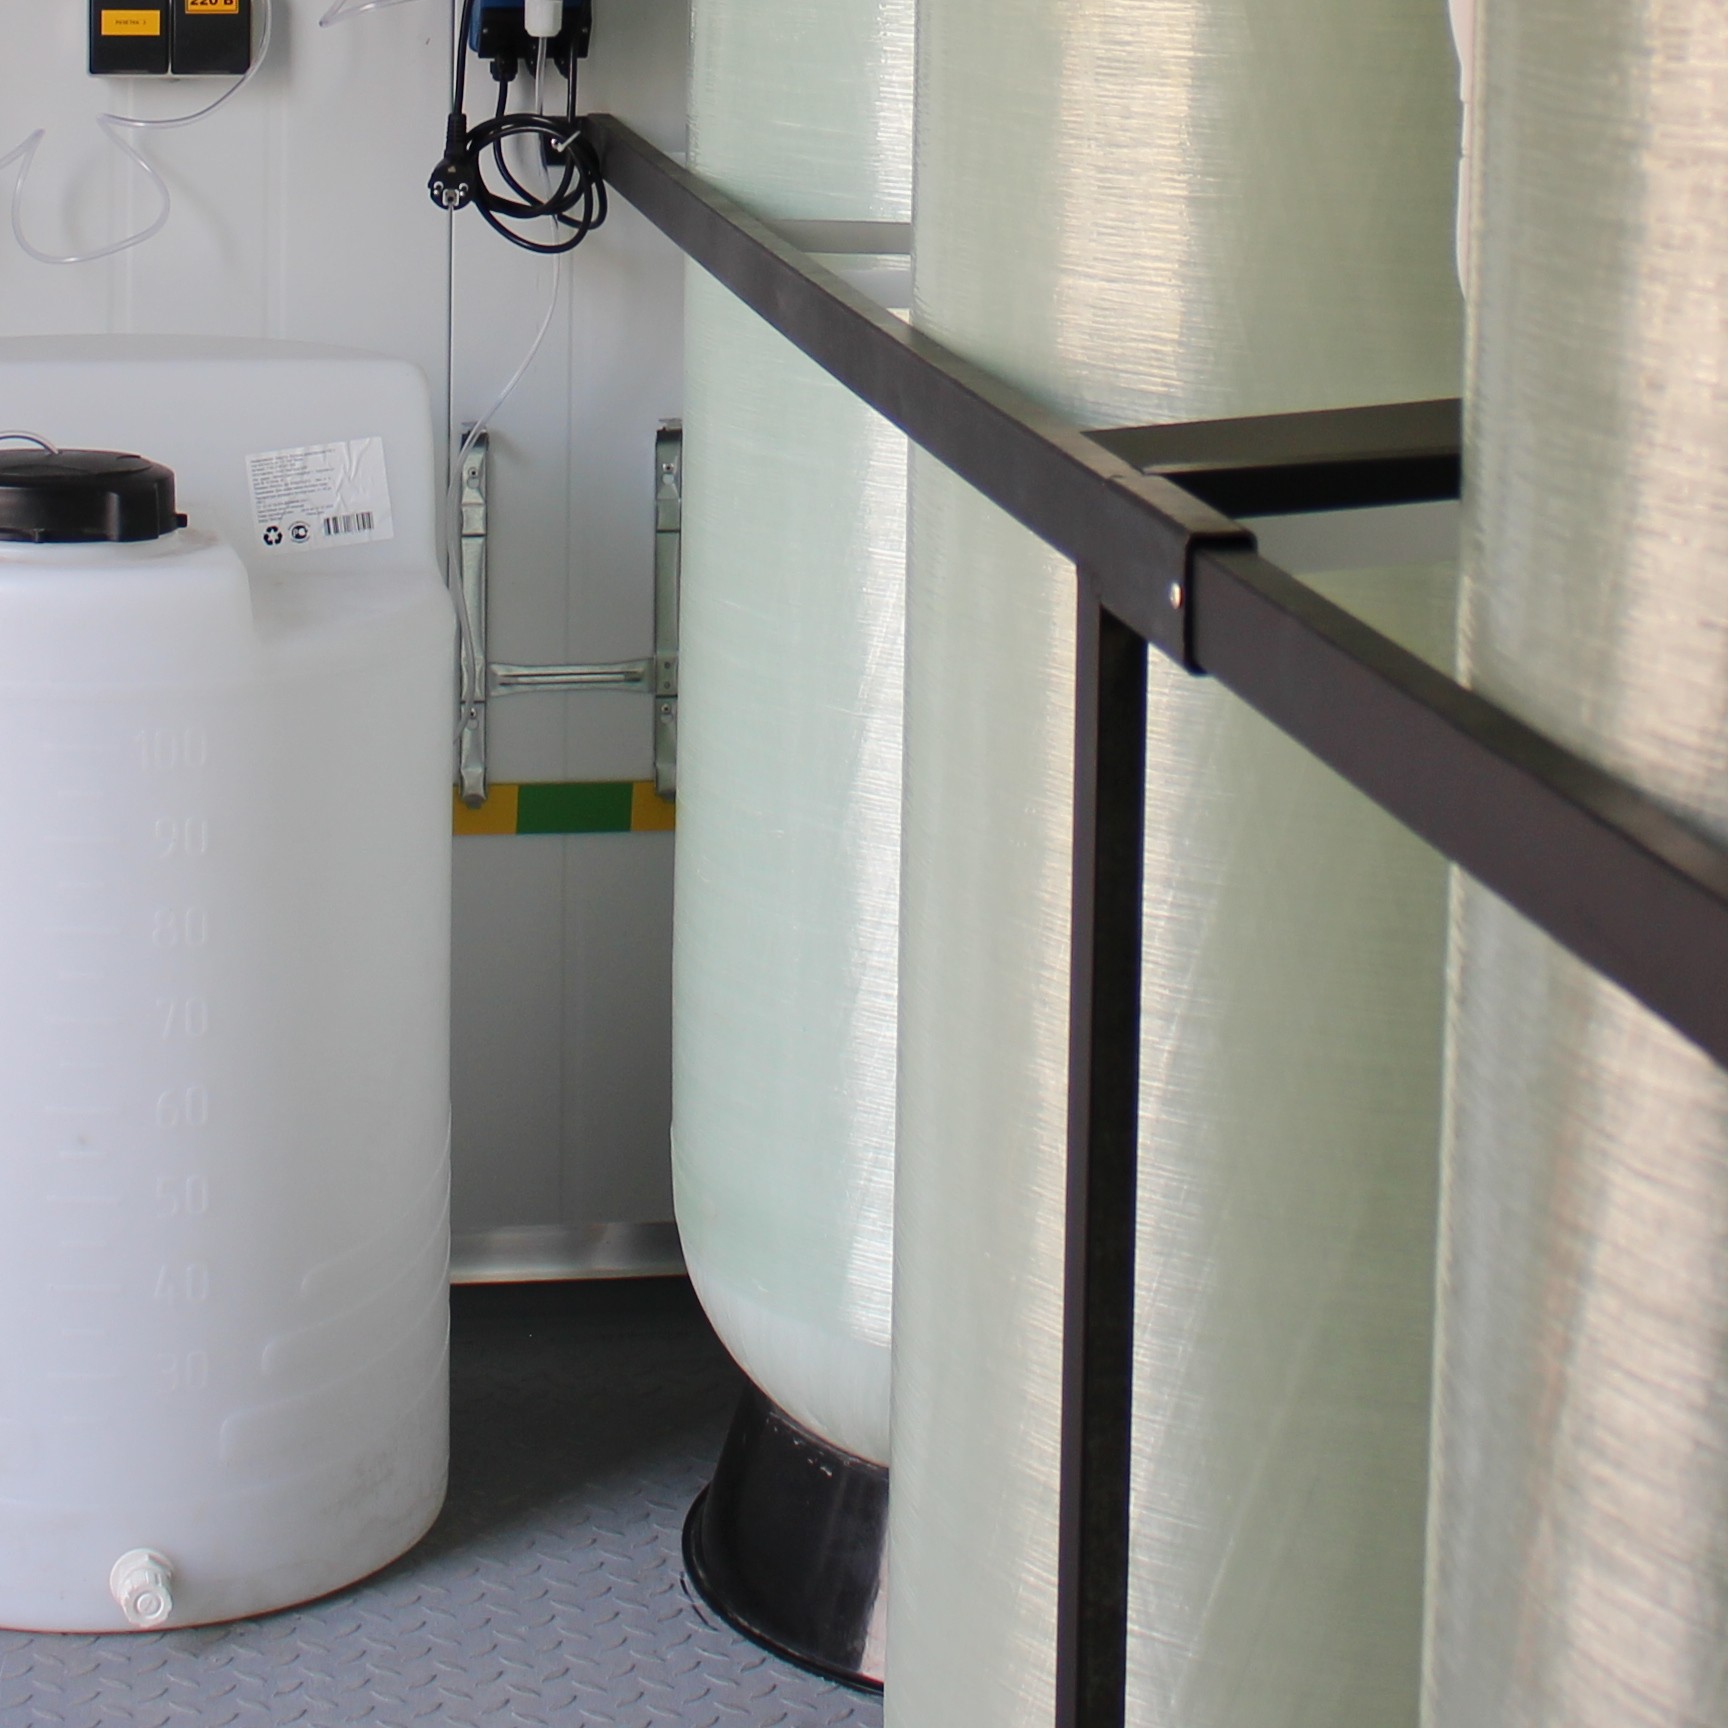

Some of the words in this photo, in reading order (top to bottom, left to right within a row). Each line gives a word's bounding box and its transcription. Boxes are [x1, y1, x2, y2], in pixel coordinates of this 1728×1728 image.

[135, 727, 208, 774] 100
[153, 815, 209, 860] 90
[151, 905, 209, 949] 80
[155, 994, 209, 1041] 70
[154, 1082, 209, 1129] 60
[154, 1172, 209, 1219] 50
[152, 1261, 209, 1306] 40
